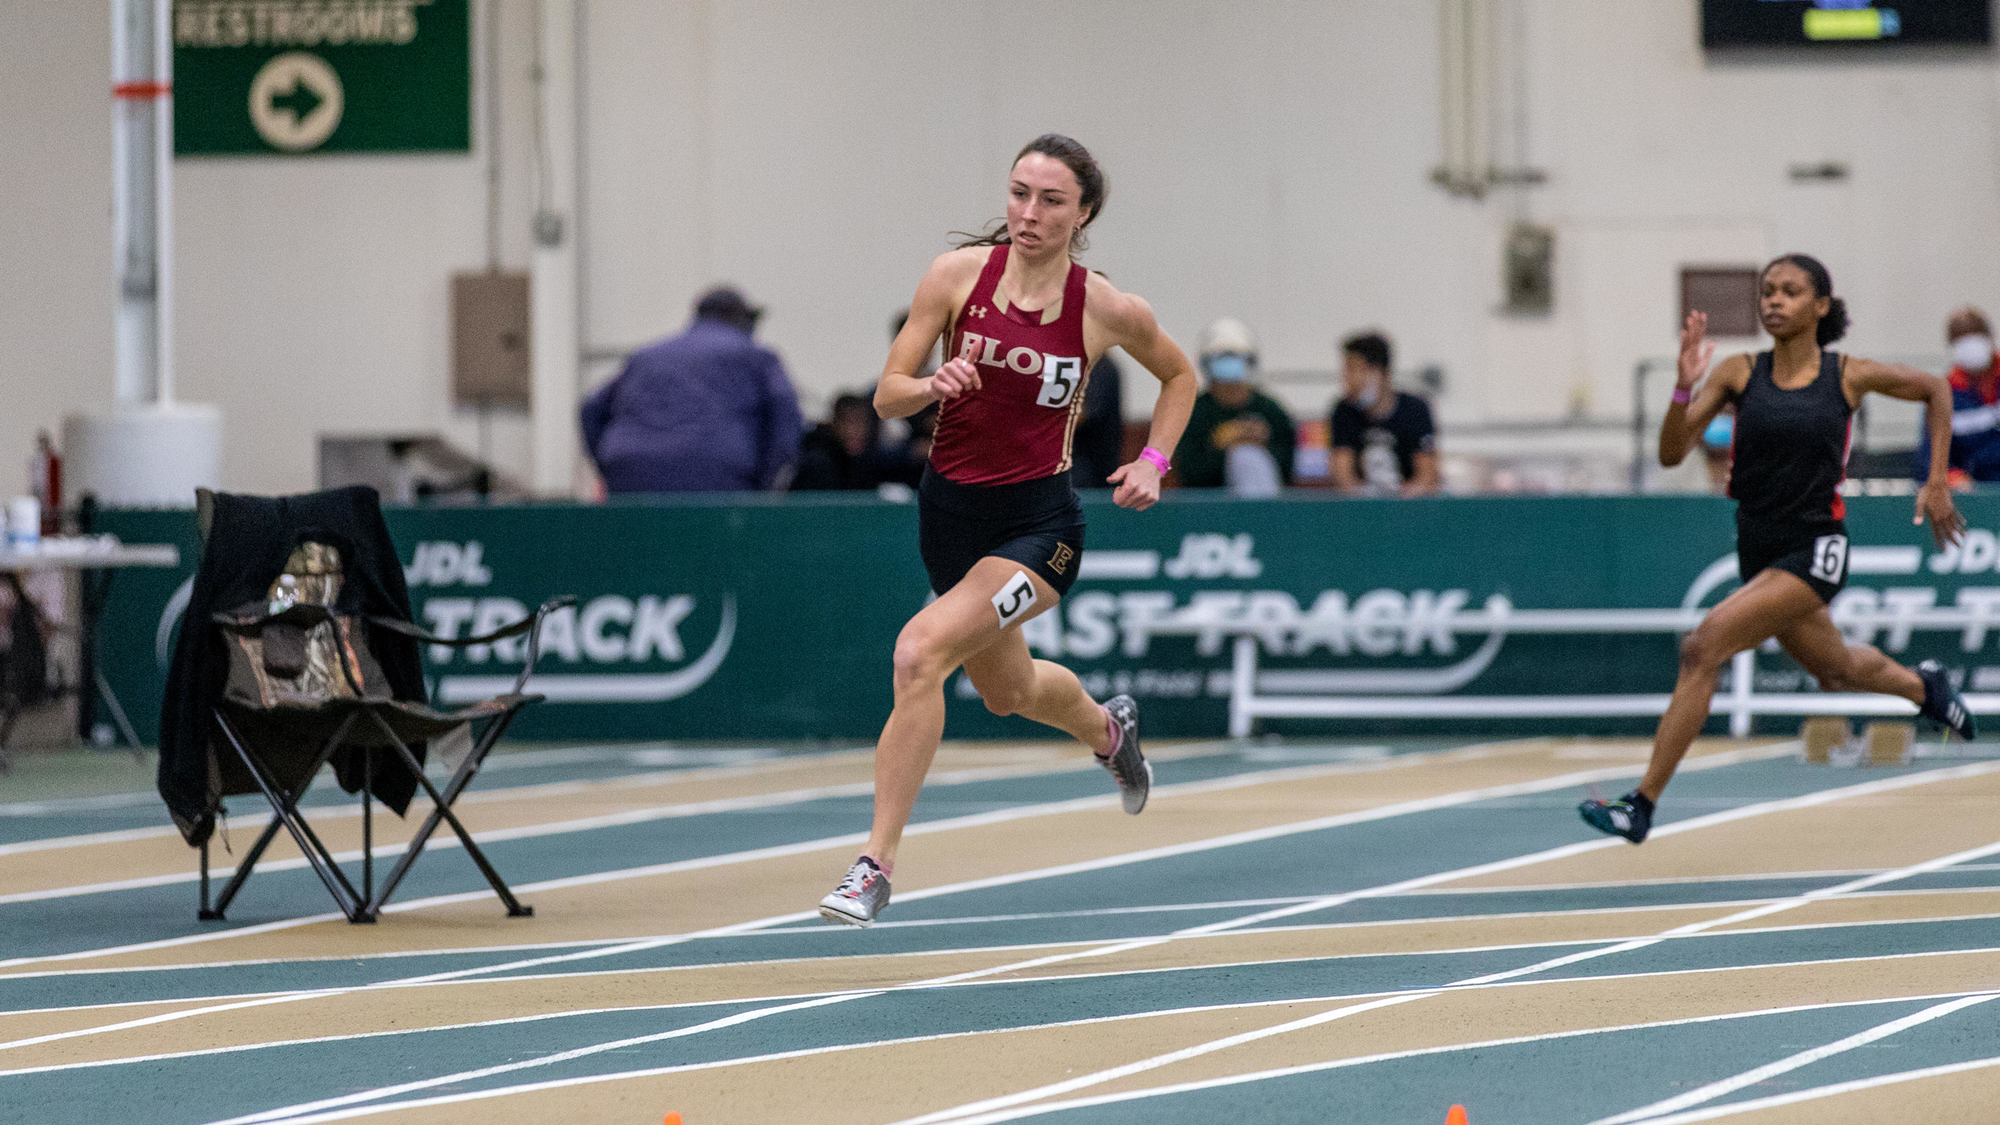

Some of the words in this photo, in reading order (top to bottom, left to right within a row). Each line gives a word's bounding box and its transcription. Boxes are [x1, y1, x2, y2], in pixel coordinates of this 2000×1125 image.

[173, 3, 418, 46] RESTROOMS
[959, 331, 1058, 379] ELO
[1047, 361, 1074, 405] 5
[402, 541, 492, 586] JDL
[1047, 541, 1074, 575] E
[1164, 533, 1262, 579] JDL
[1823, 539, 1840, 576] 6
[1927, 528, 2000, 574] JD
[998, 580, 1033, 618] 5
[423, 595, 696, 664] TRACK
[1190, 588, 1469, 656] TRACK
